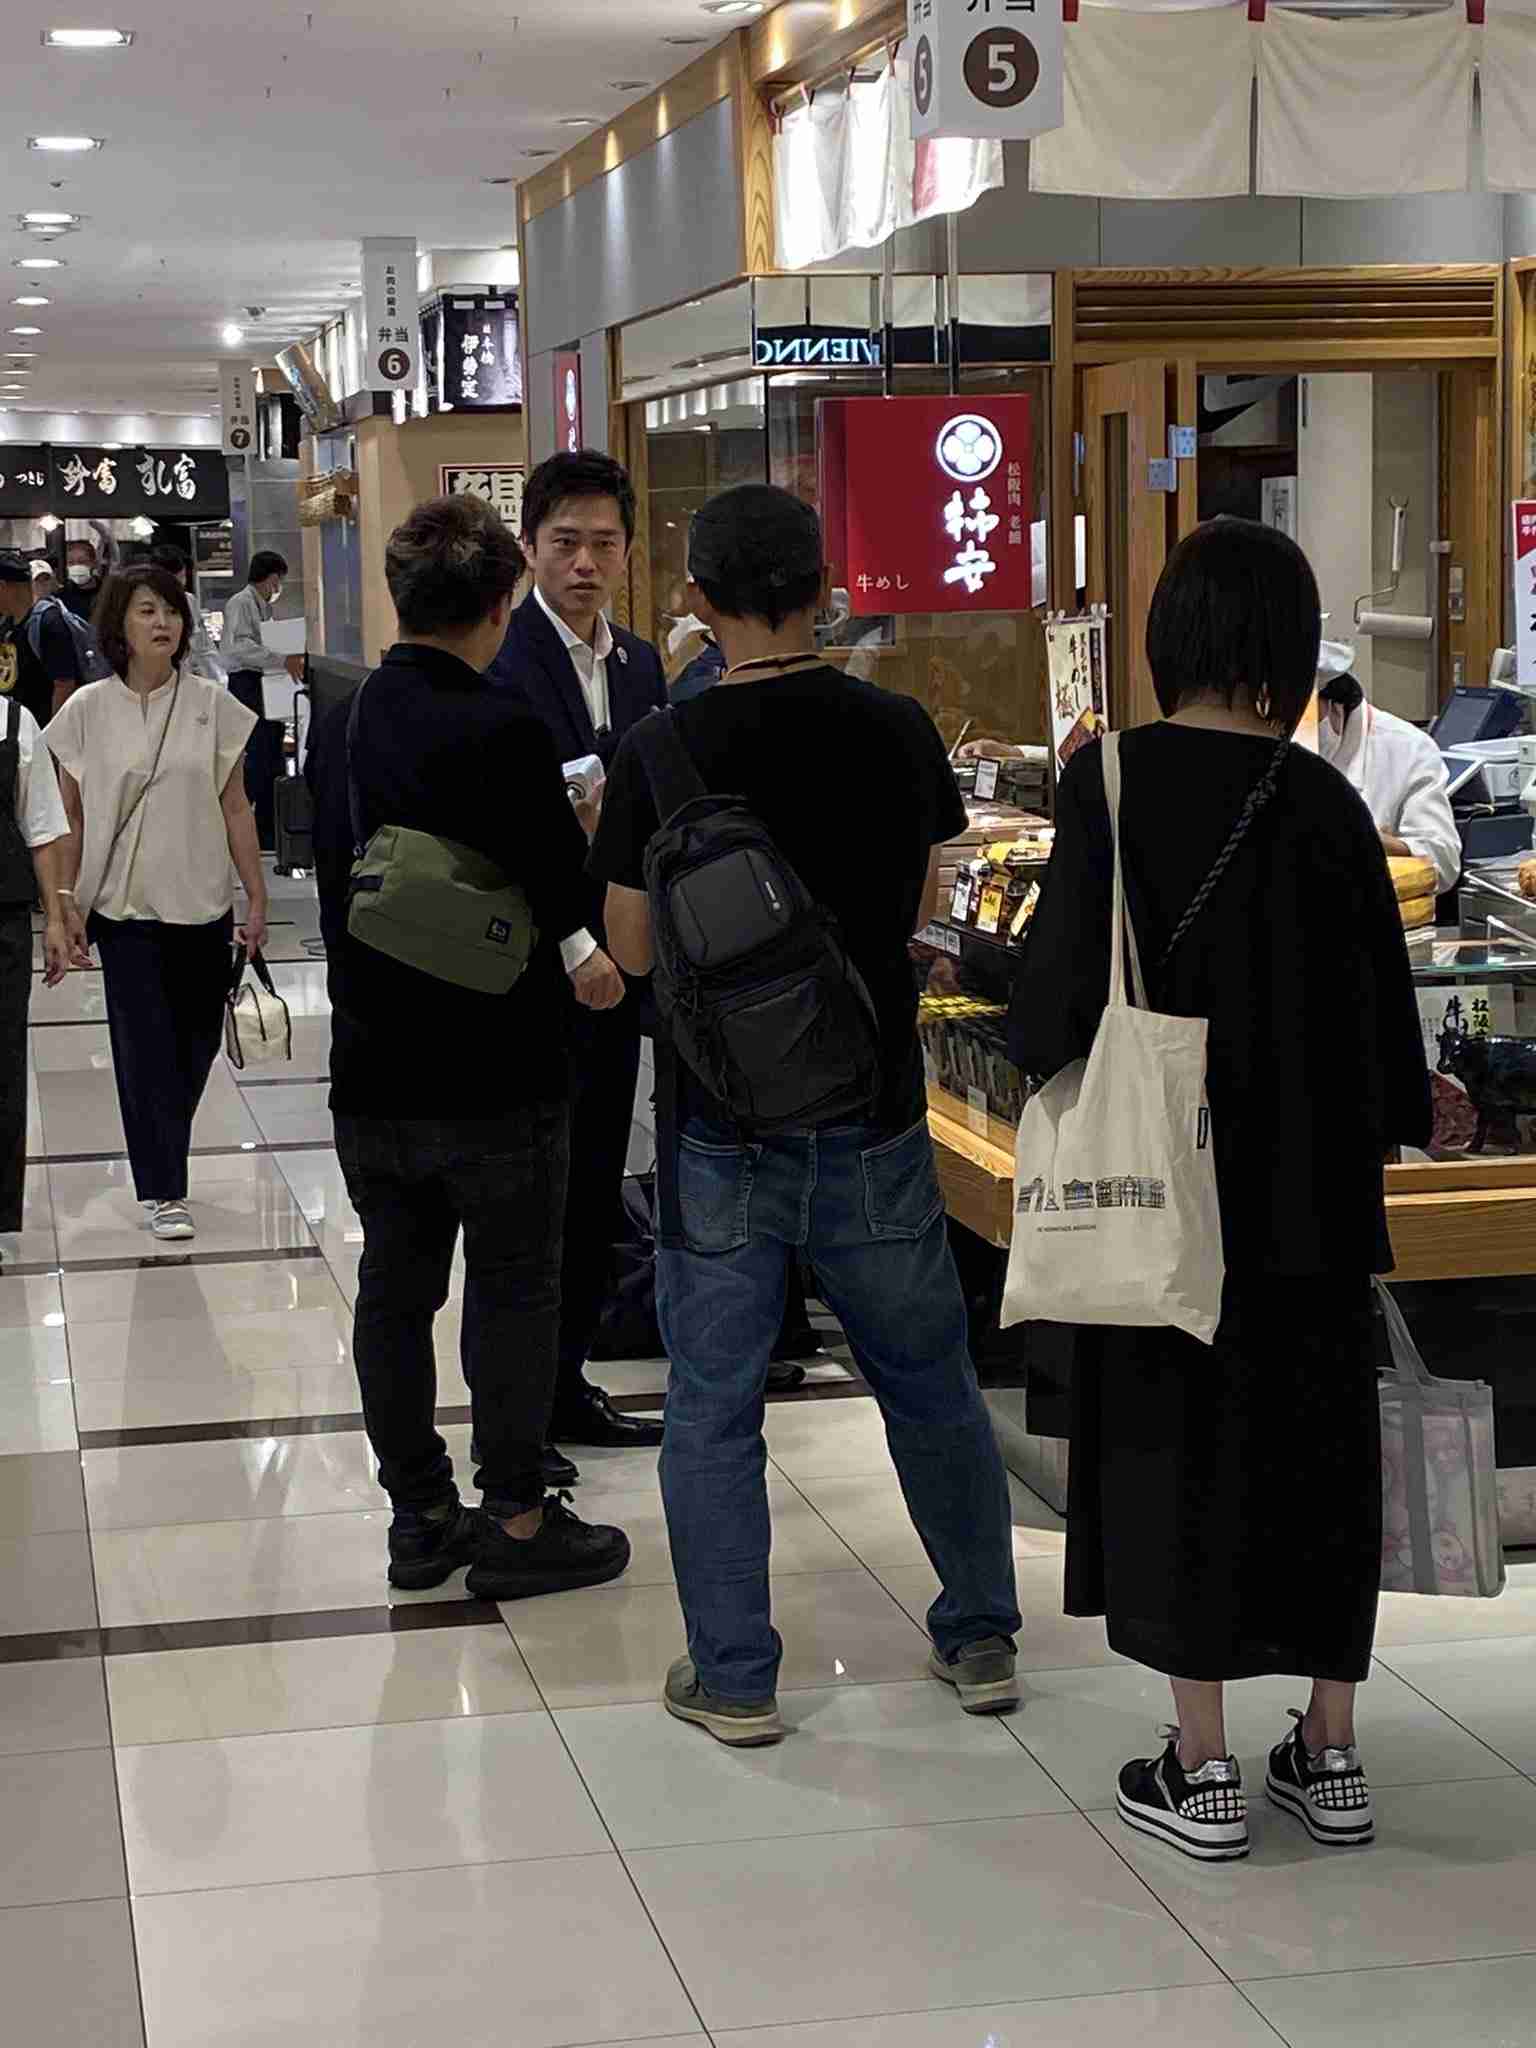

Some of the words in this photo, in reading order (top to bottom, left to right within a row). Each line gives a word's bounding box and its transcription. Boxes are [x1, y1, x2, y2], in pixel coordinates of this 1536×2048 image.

[377, 327, 409, 343] 弁当
[460, 333, 480, 399] 伊勢定
[15, 471, 45, 487] つきじ
[944, 486, 1000, 593] 柿安
[856, 573, 909, 593] 牛めし
